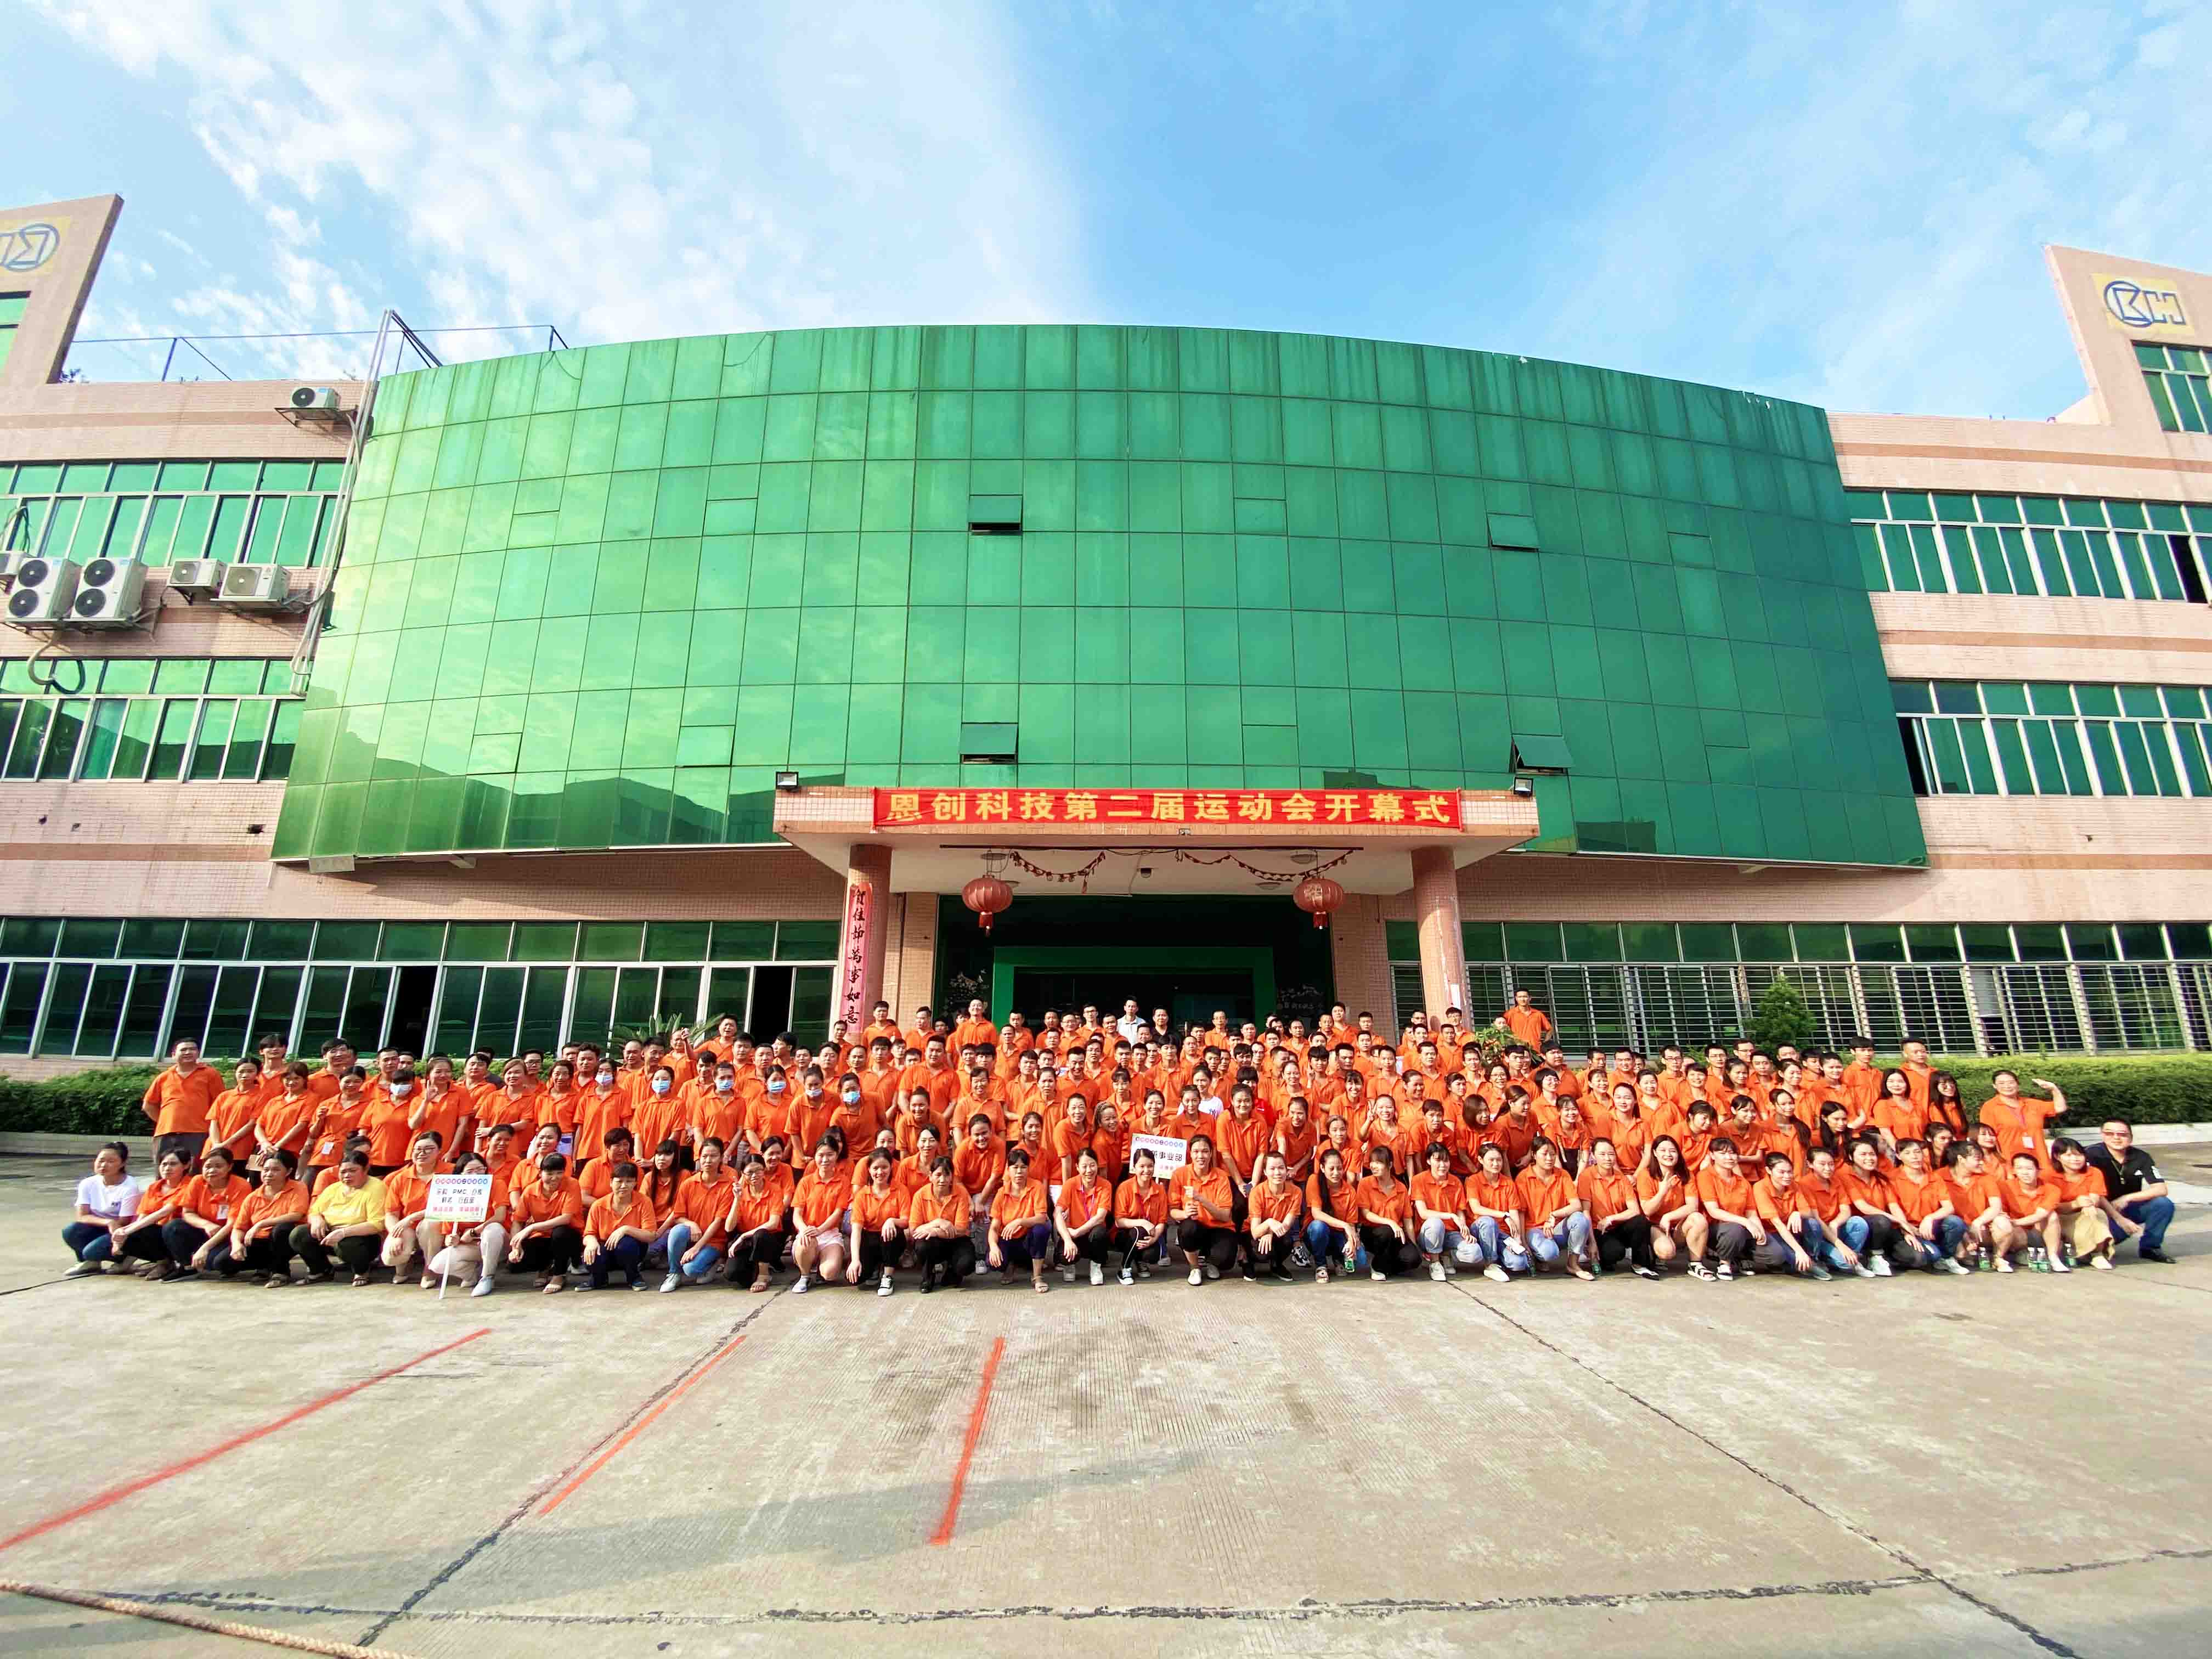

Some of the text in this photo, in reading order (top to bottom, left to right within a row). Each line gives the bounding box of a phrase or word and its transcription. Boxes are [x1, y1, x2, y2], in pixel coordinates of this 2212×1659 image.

[887, 791, 1450, 822] 恩创科技第二届运动会开幕式
